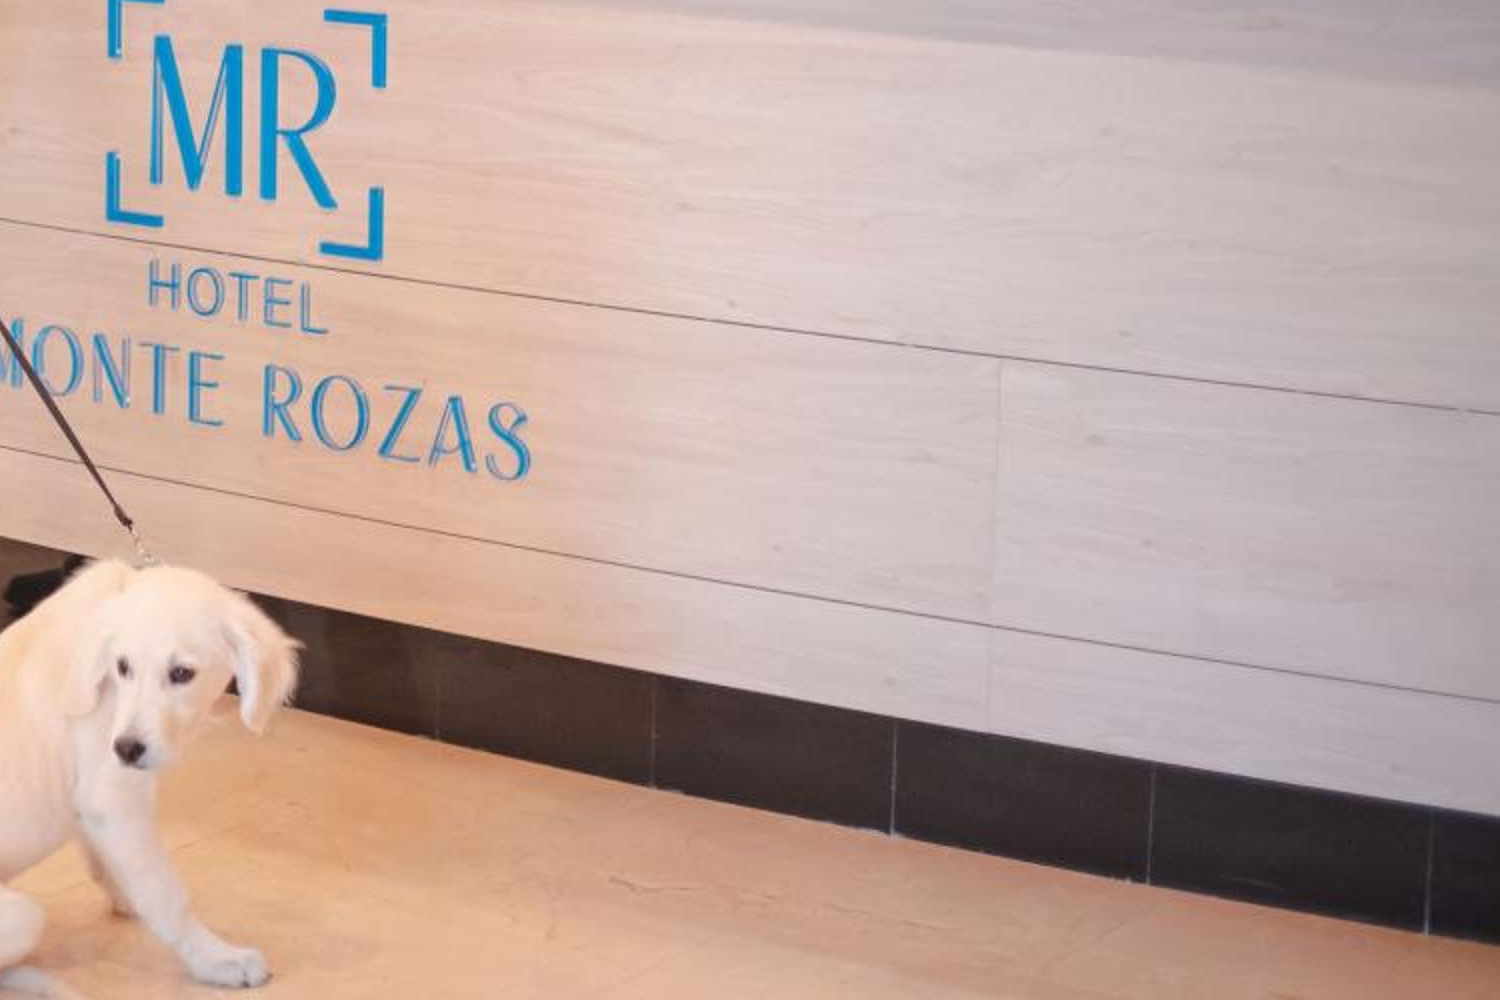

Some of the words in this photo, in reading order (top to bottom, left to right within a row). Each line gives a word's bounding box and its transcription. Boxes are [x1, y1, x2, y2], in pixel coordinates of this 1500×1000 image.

[149, 34, 338, 210] MR
[148, 259, 328, 334] HOTEL
[262, 363, 532, 481] ROZAS
